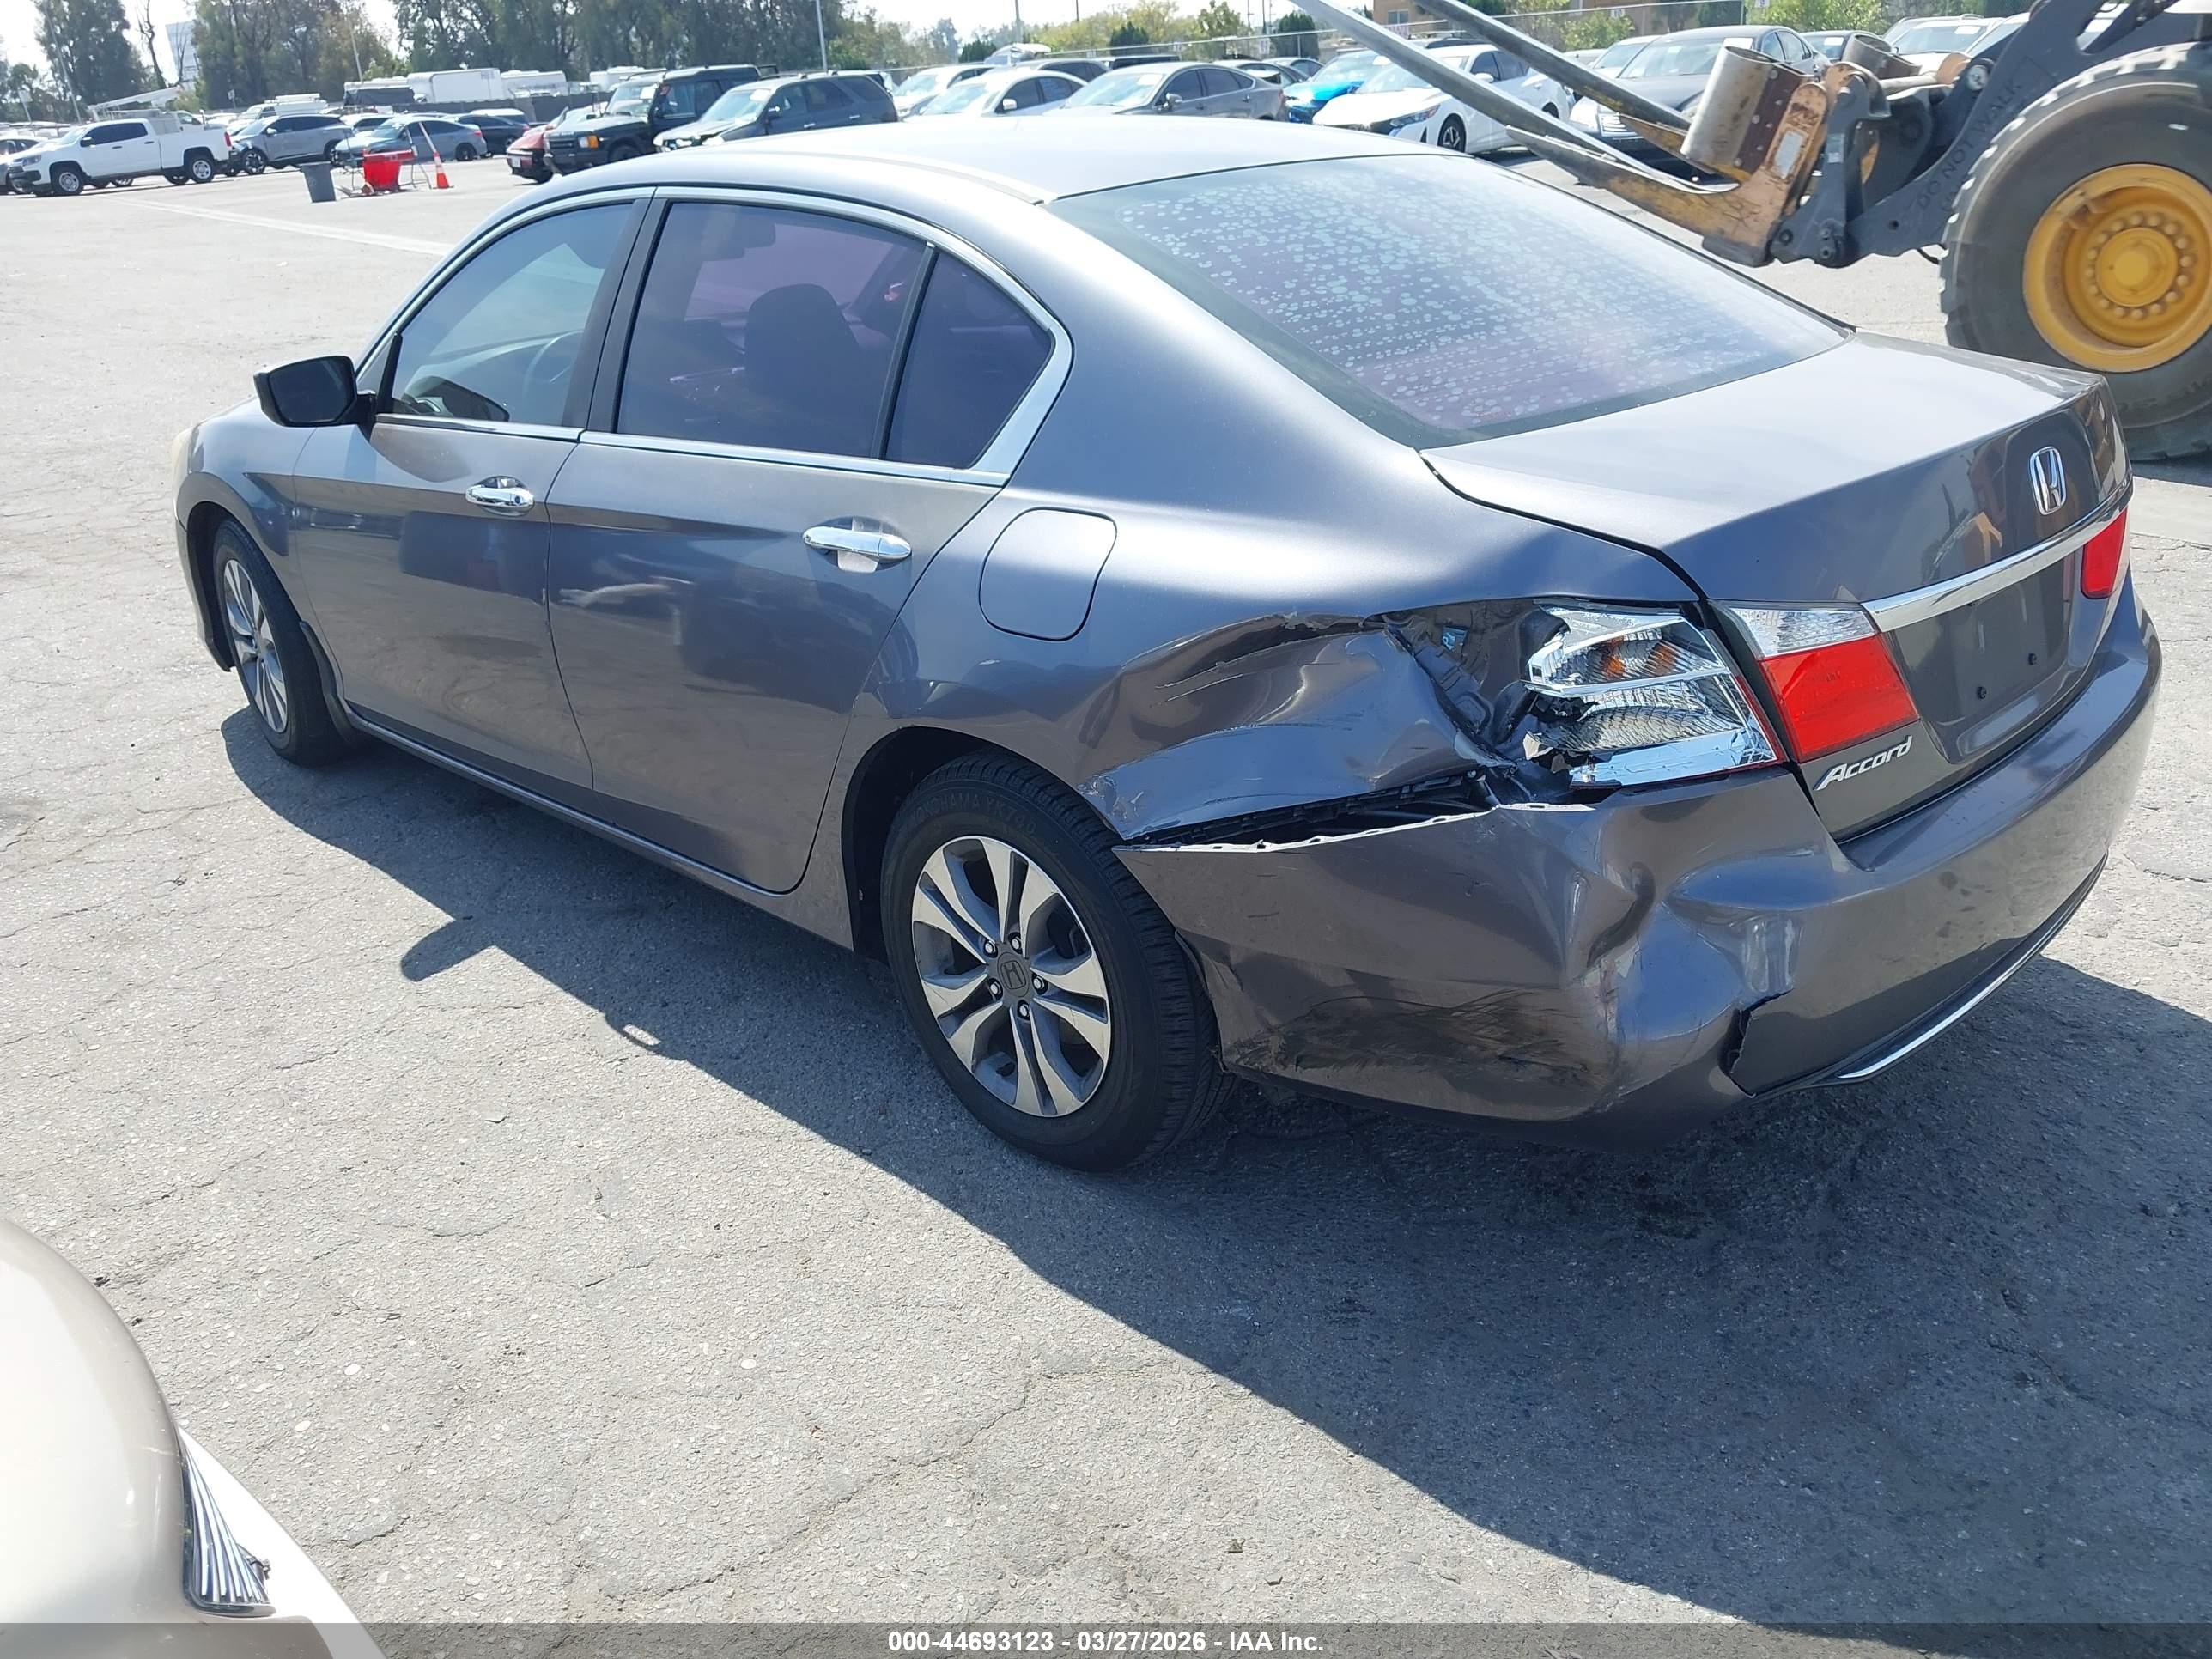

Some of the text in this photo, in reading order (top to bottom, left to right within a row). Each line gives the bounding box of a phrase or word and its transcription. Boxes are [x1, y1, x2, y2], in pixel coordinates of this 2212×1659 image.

[1942, 139, 1973, 179] NOT
[1973, 82, 2022, 133] WALK
[1813, 735, 1913, 791] Accord
